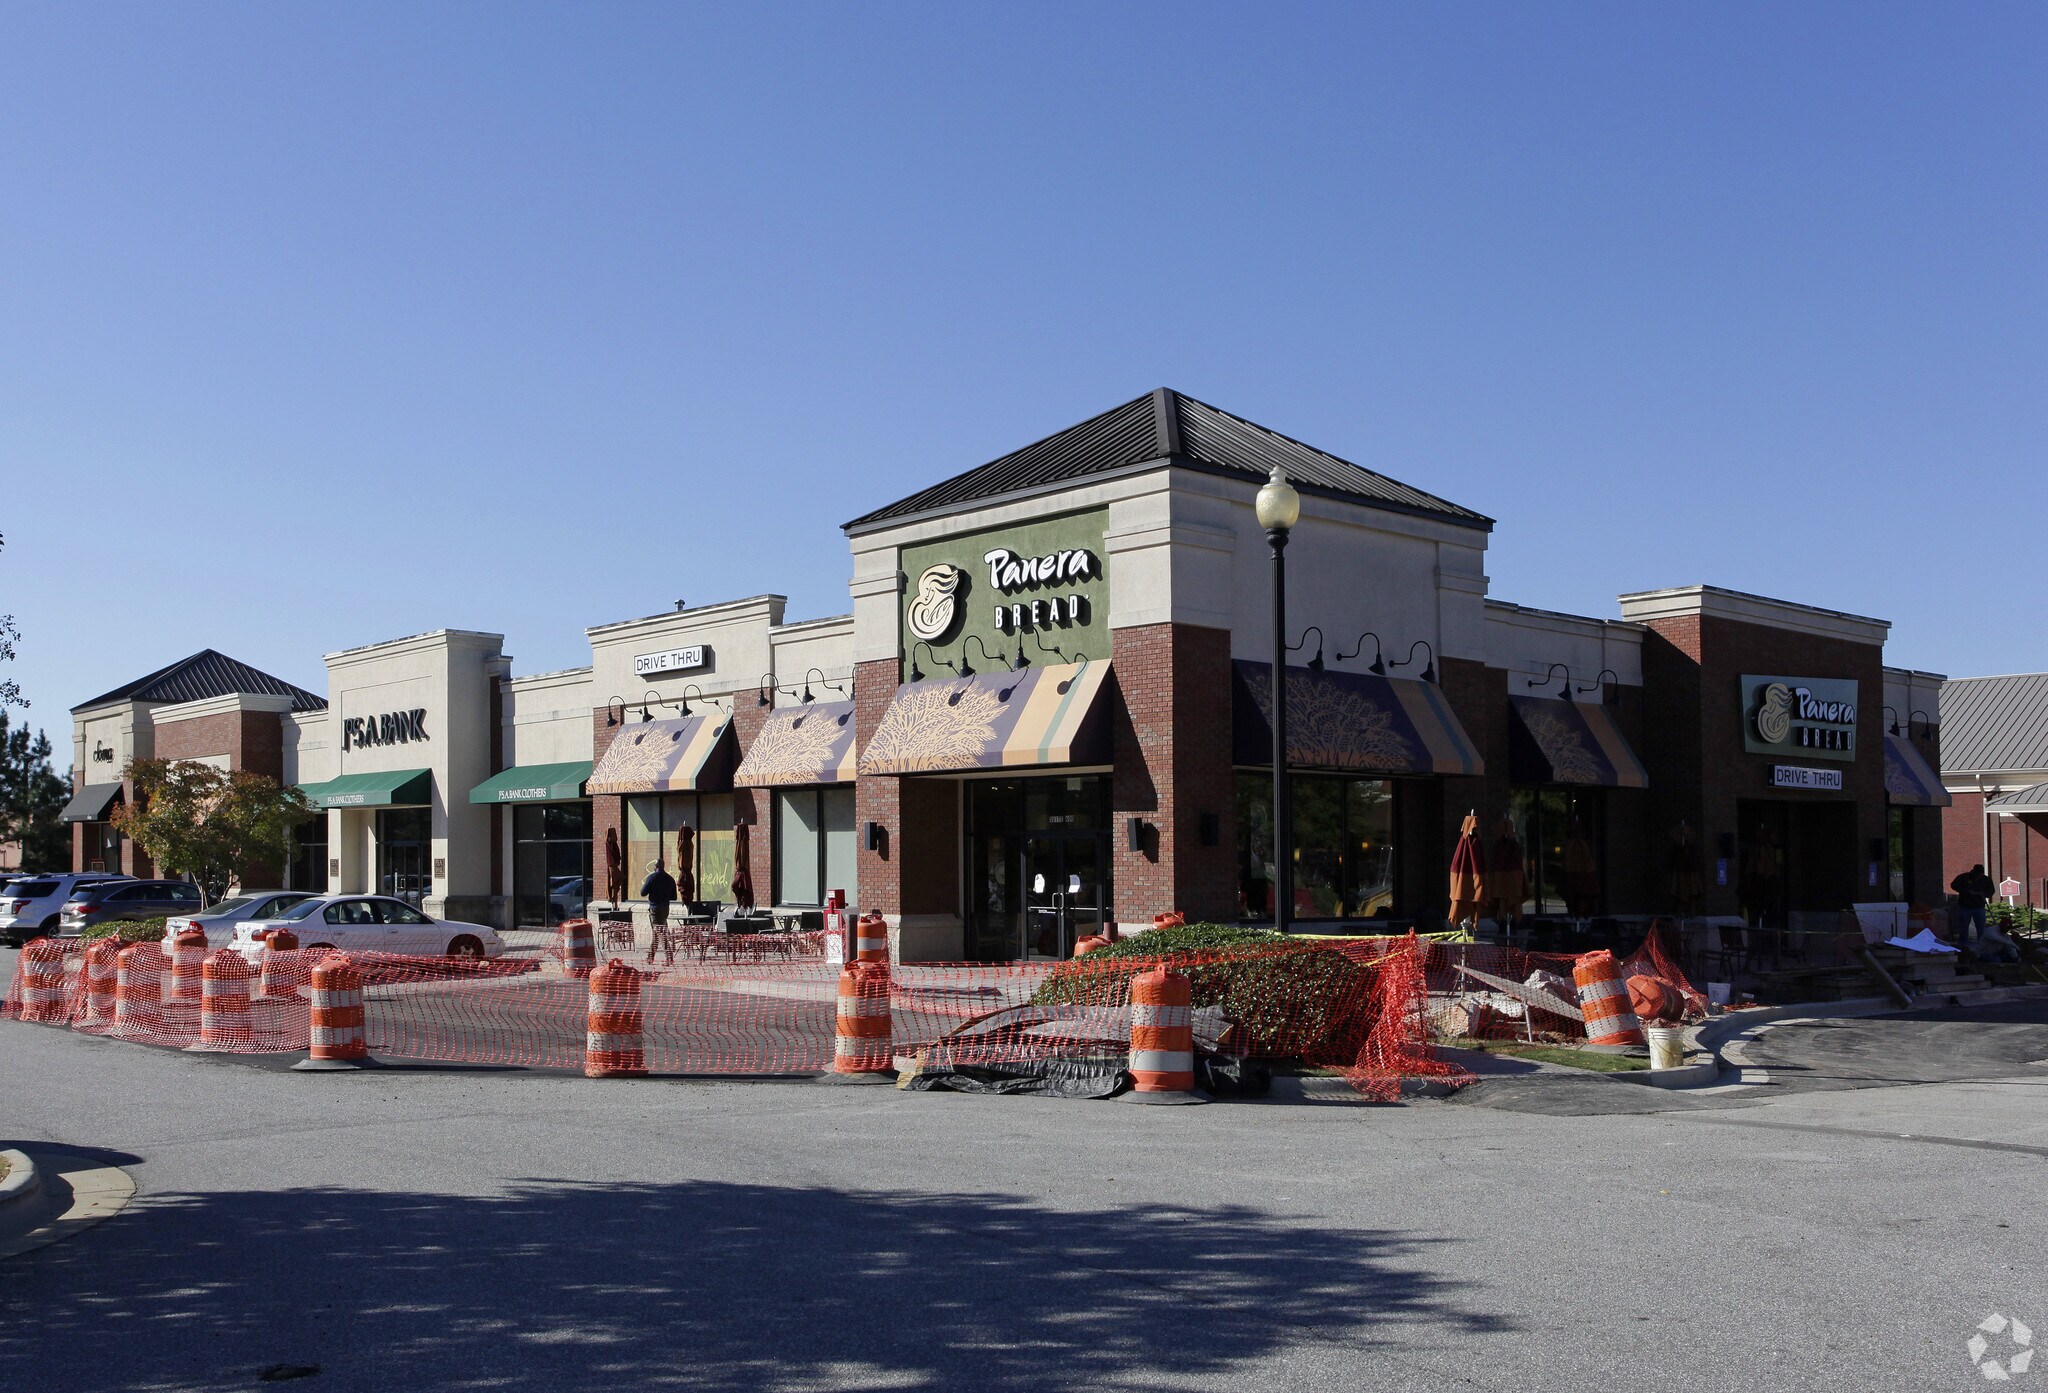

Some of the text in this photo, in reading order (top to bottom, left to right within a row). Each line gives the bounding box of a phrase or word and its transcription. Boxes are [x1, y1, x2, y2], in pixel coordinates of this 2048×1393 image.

[983, 548, 1089, 590] Panera
[994, 594, 1078, 629] BREAD
[637, 650, 700, 671] DRIVE THRU
[1796, 687, 1855, 724] Panera
[380, 708, 430, 745] BANK
[1803, 727, 1852, 750] BREAD
[1776, 769, 1840, 786] DRIVE THRU
[509, 789, 522, 799] BANK
[521, 788, 547, 798] CLOTHIERS
